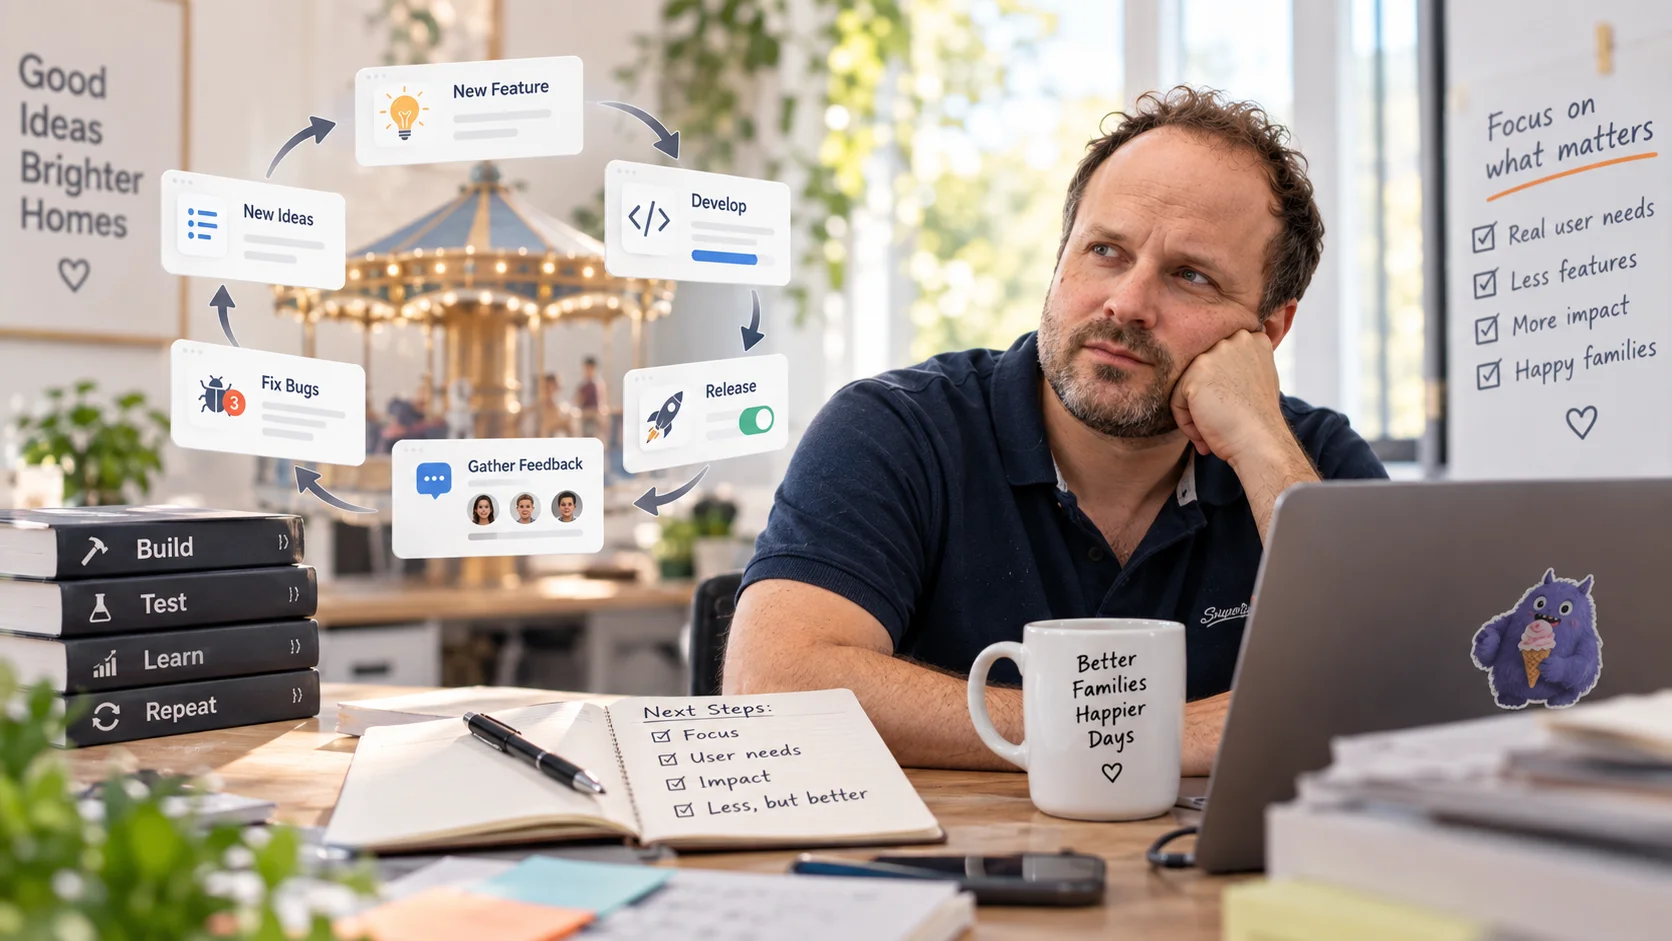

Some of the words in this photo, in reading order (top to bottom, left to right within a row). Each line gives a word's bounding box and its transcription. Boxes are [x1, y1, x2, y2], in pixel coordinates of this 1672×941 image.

[18, 53, 107, 99] Good
[20, 102, 103, 145] Ideas
[1486, 108, 1555, 142] Focus
[1567, 98, 1596, 119] on
[1485, 141, 1545, 180] what
[1558, 121, 1655, 161] matters
[20, 150, 144, 197] Brighter
[20, 196, 128, 238] Homes
[1508, 217, 1546, 245] Real
[1555, 216, 1594, 235] user
[1602, 196, 1655, 225] needs
[1511, 271, 1550, 291] Less
[1558, 253, 1638, 283] features
[1512, 315, 1558, 336] More
[1566, 294, 1631, 330] impact
[1515, 358, 1575, 384] Happy
[1583, 338, 1657, 369] families
[137, 536, 194, 559] Build
[140, 593, 188, 614] Test
[144, 650, 204, 669] Learn
[1076, 651, 1138, 673] Better
[1072, 675, 1147, 698] Families
[146, 697, 218, 722] Repeat
[643, 704, 697, 719] Next
[707, 703, 774, 718] Steps:
[1075, 704, 1147, 727] Happier
[683, 728, 740, 742] Focus
[1087, 731, 1135, 753] Days
[690, 751, 736, 764] User
[745, 743, 802, 760] needs
[698, 770, 771, 791] Impact
[707, 801, 758, 816] Less,
[763, 792, 799, 809] but
[806, 788, 868, 805] better
